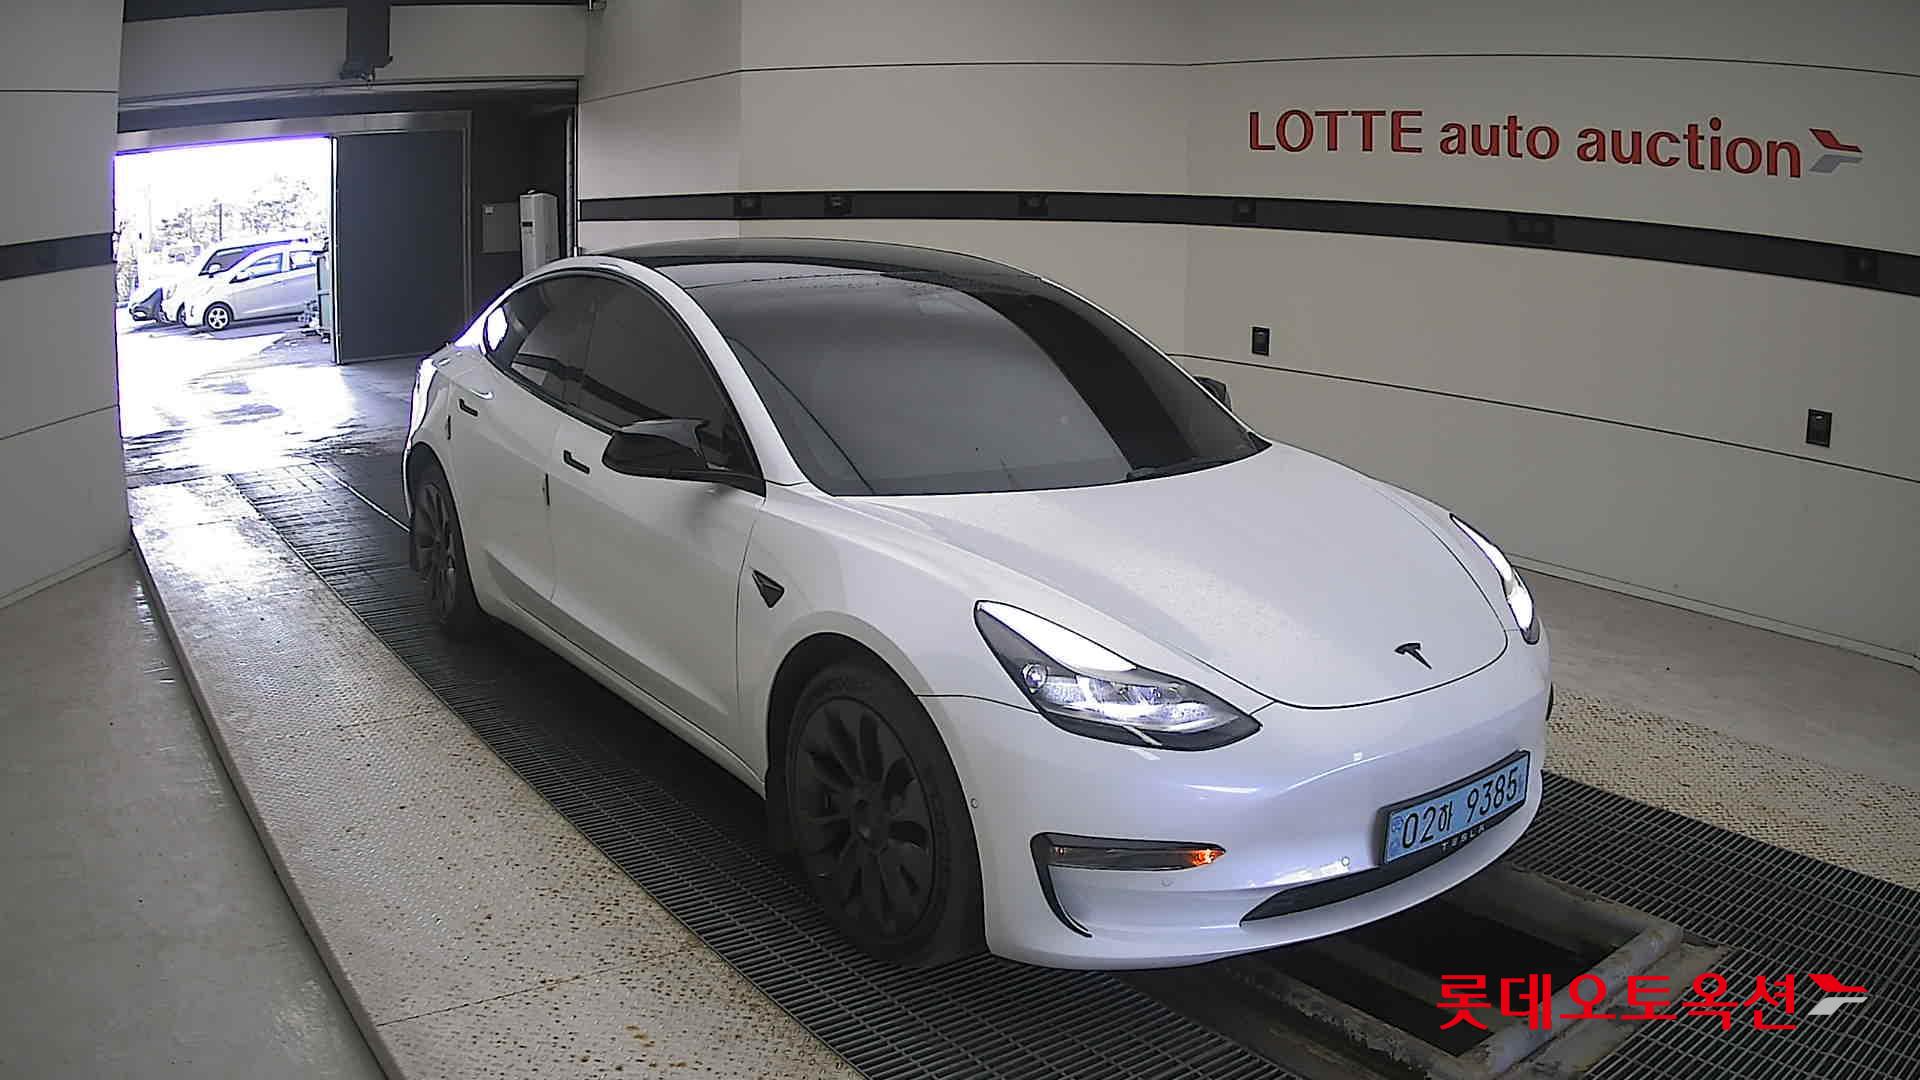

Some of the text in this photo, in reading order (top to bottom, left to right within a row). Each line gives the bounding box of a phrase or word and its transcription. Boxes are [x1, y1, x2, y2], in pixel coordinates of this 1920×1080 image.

[1249, 110, 1802, 179] LOTTE auto auction
[1466, 766, 1518, 824] 9385
[1440, 823, 1487, 851] TESLA
